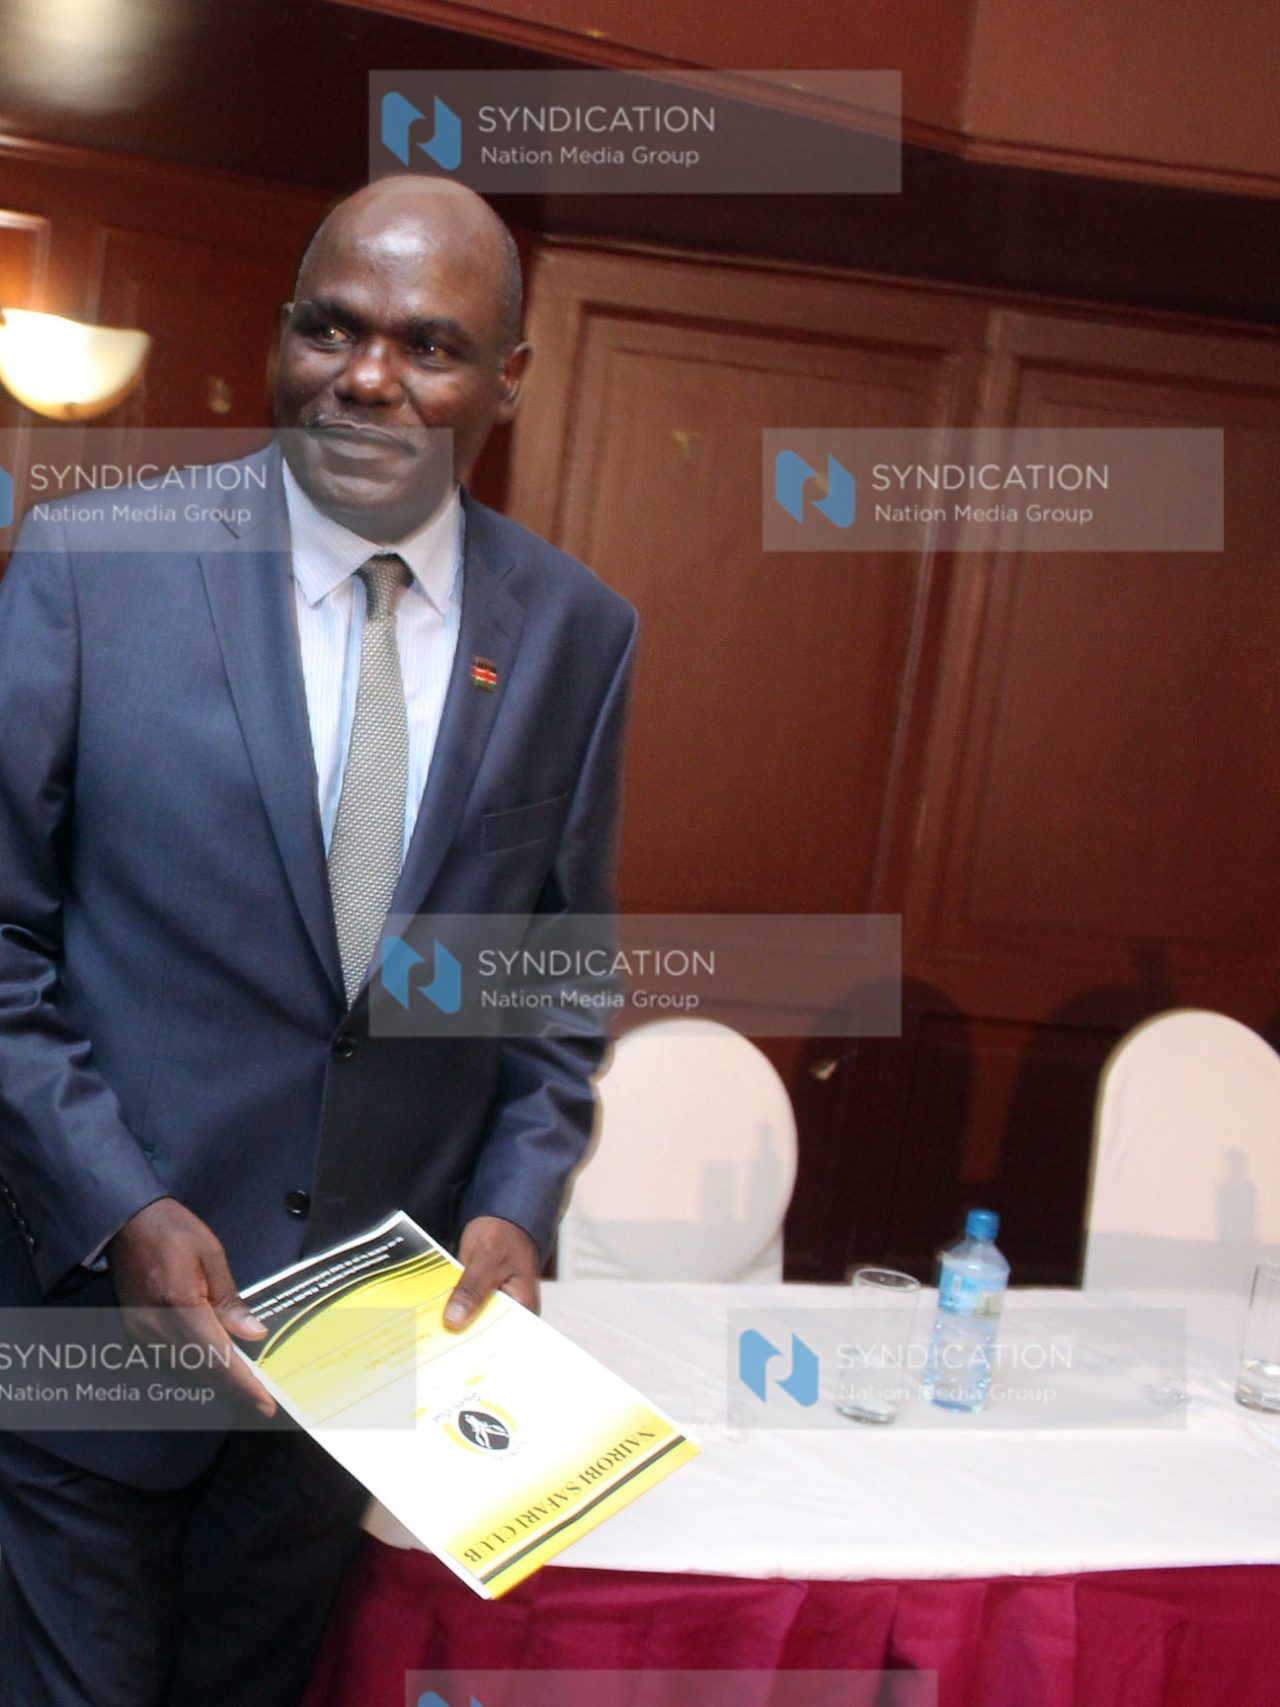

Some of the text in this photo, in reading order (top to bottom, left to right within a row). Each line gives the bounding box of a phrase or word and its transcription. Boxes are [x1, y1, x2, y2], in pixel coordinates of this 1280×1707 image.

[578, 1425, 656, 1485] NAIROBI
[515, 1480, 582, 1529] SAFARI
[464, 1525, 517, 1563] CLUB
